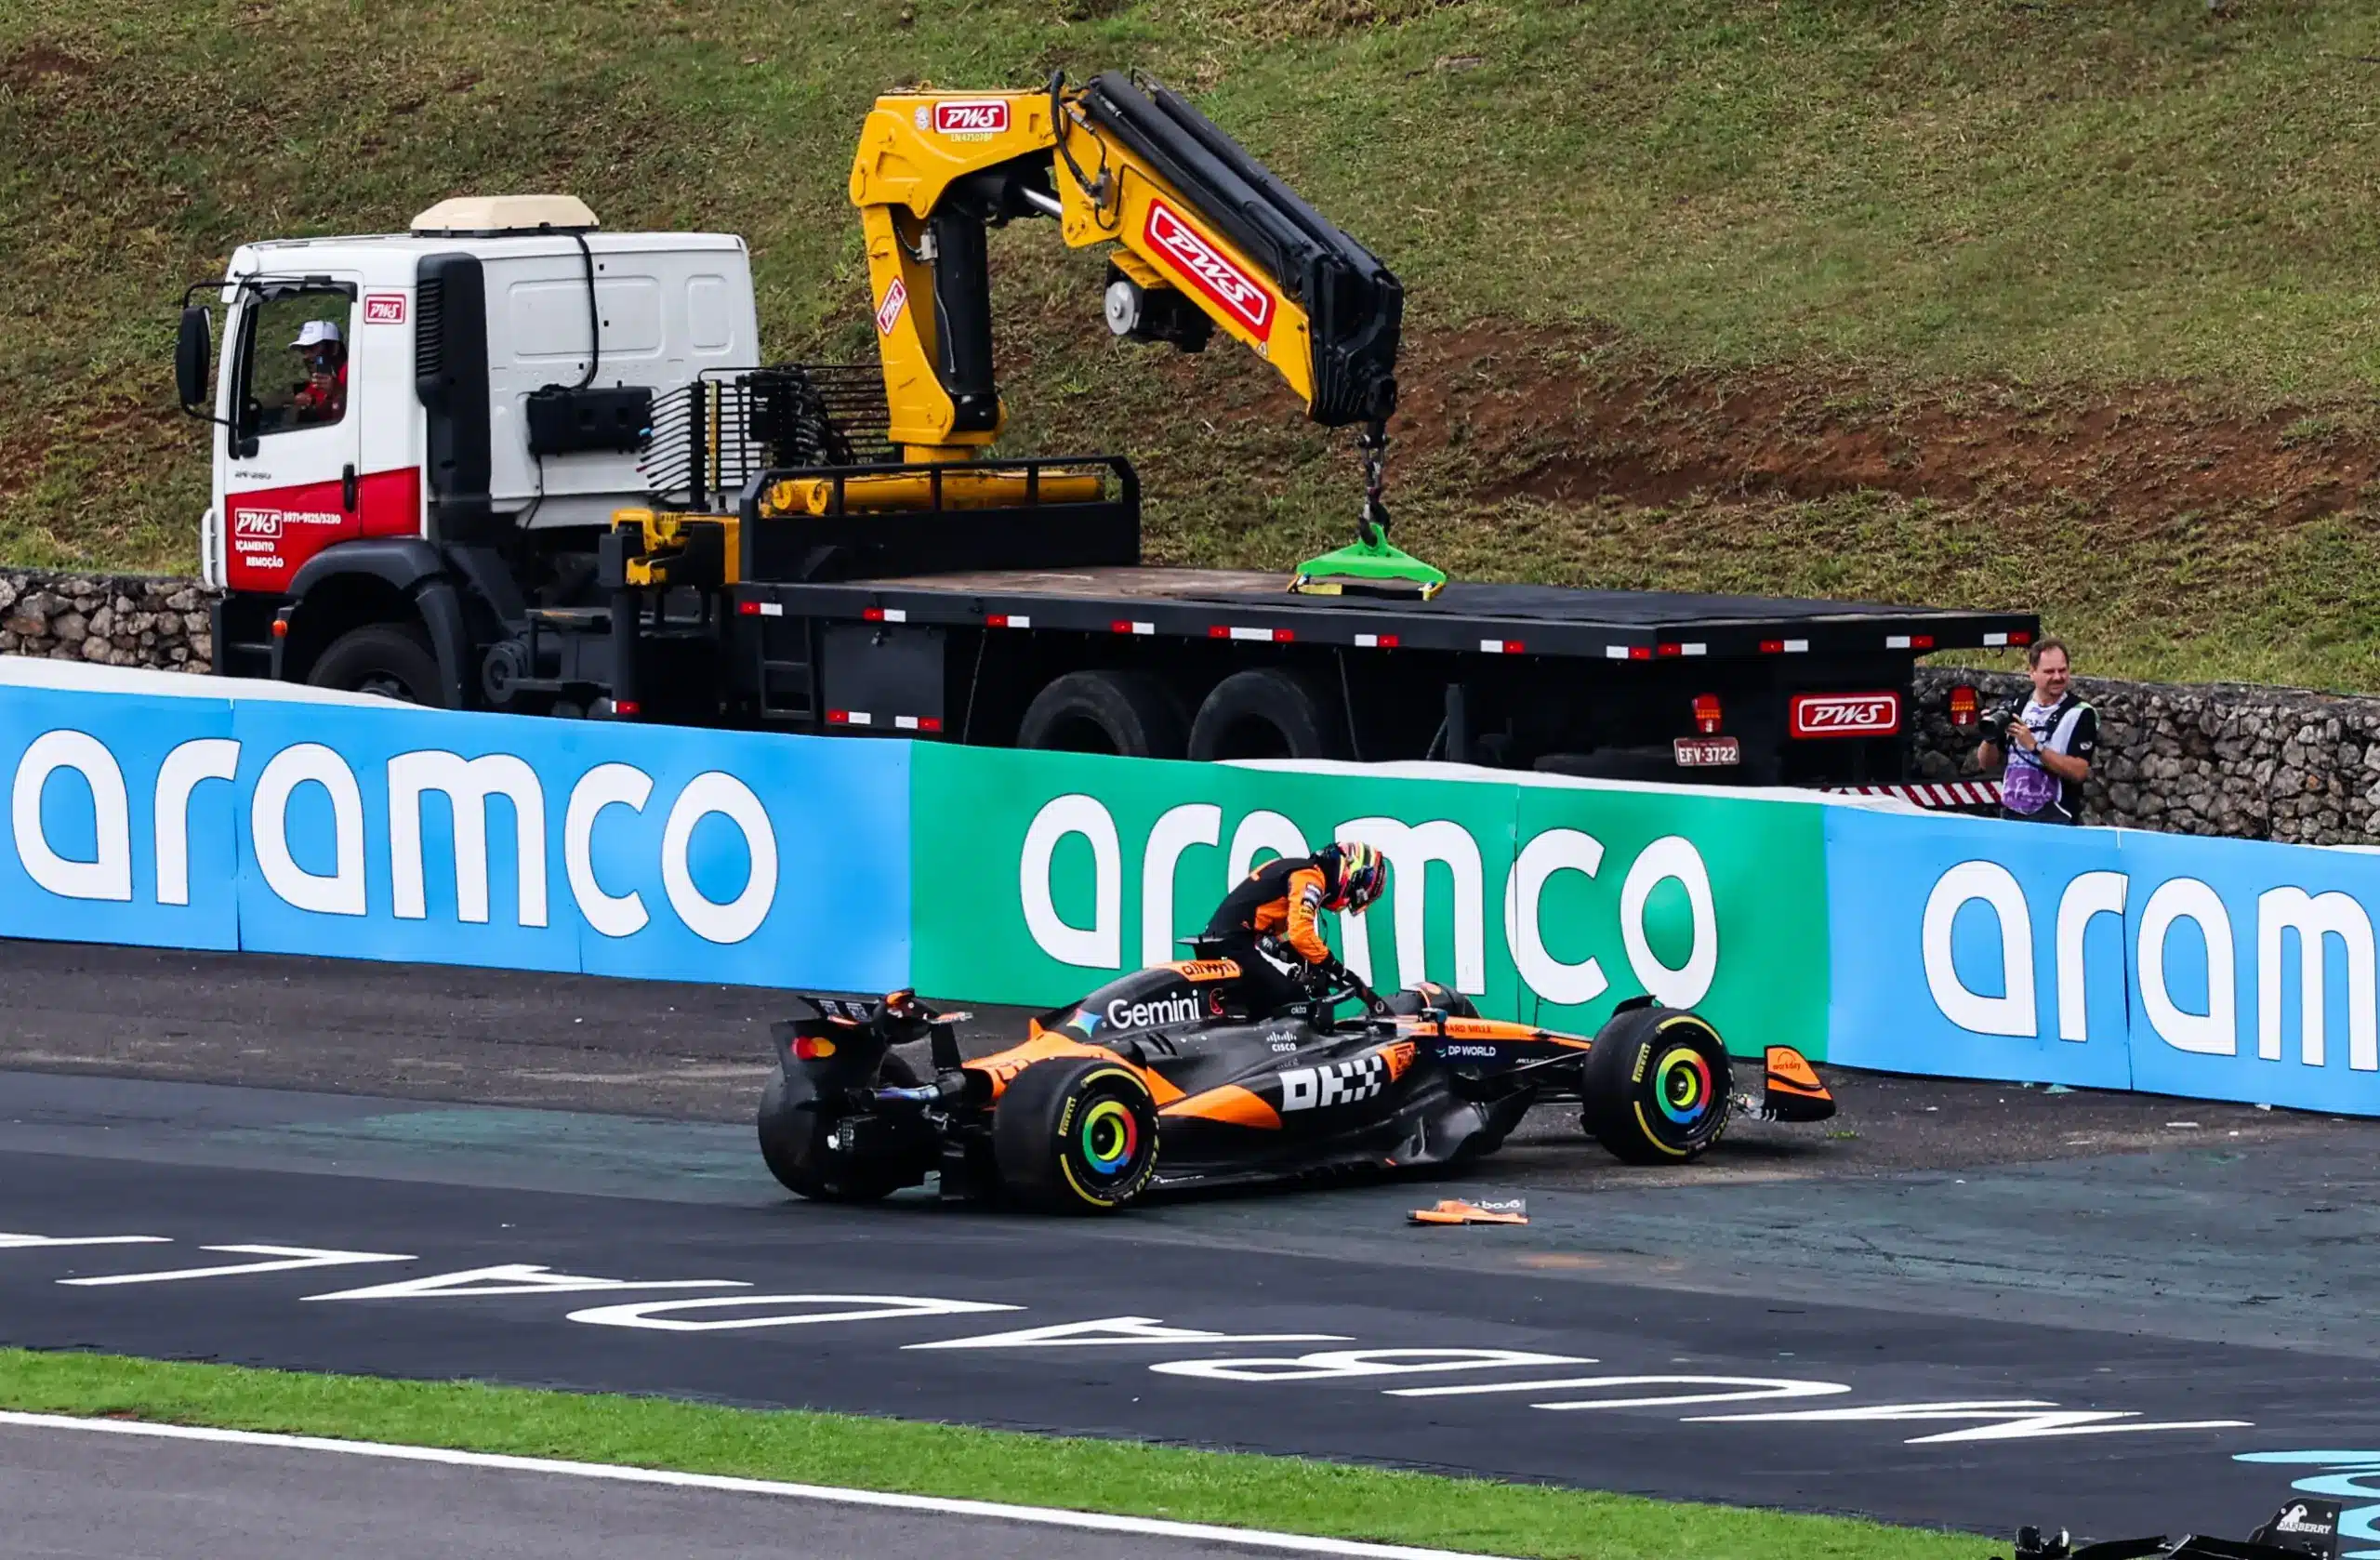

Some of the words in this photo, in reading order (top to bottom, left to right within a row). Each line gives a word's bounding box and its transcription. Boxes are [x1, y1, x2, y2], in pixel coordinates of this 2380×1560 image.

[945, 107, 1000, 127] PWS
[1166, 228, 1255, 302] PWS
[370, 303, 401, 319] PWS
[236, 512, 280, 534] PWS
[1811, 704, 1885, 725] PWS
[11, 728, 779, 945] aramco
[1107, 989, 1201, 1029] Gemini
[1448, 1045, 1461, 1055] DP
[1461, 1045, 1496, 1057] WORLD
[1278, 1055, 1382, 1112] OKX
